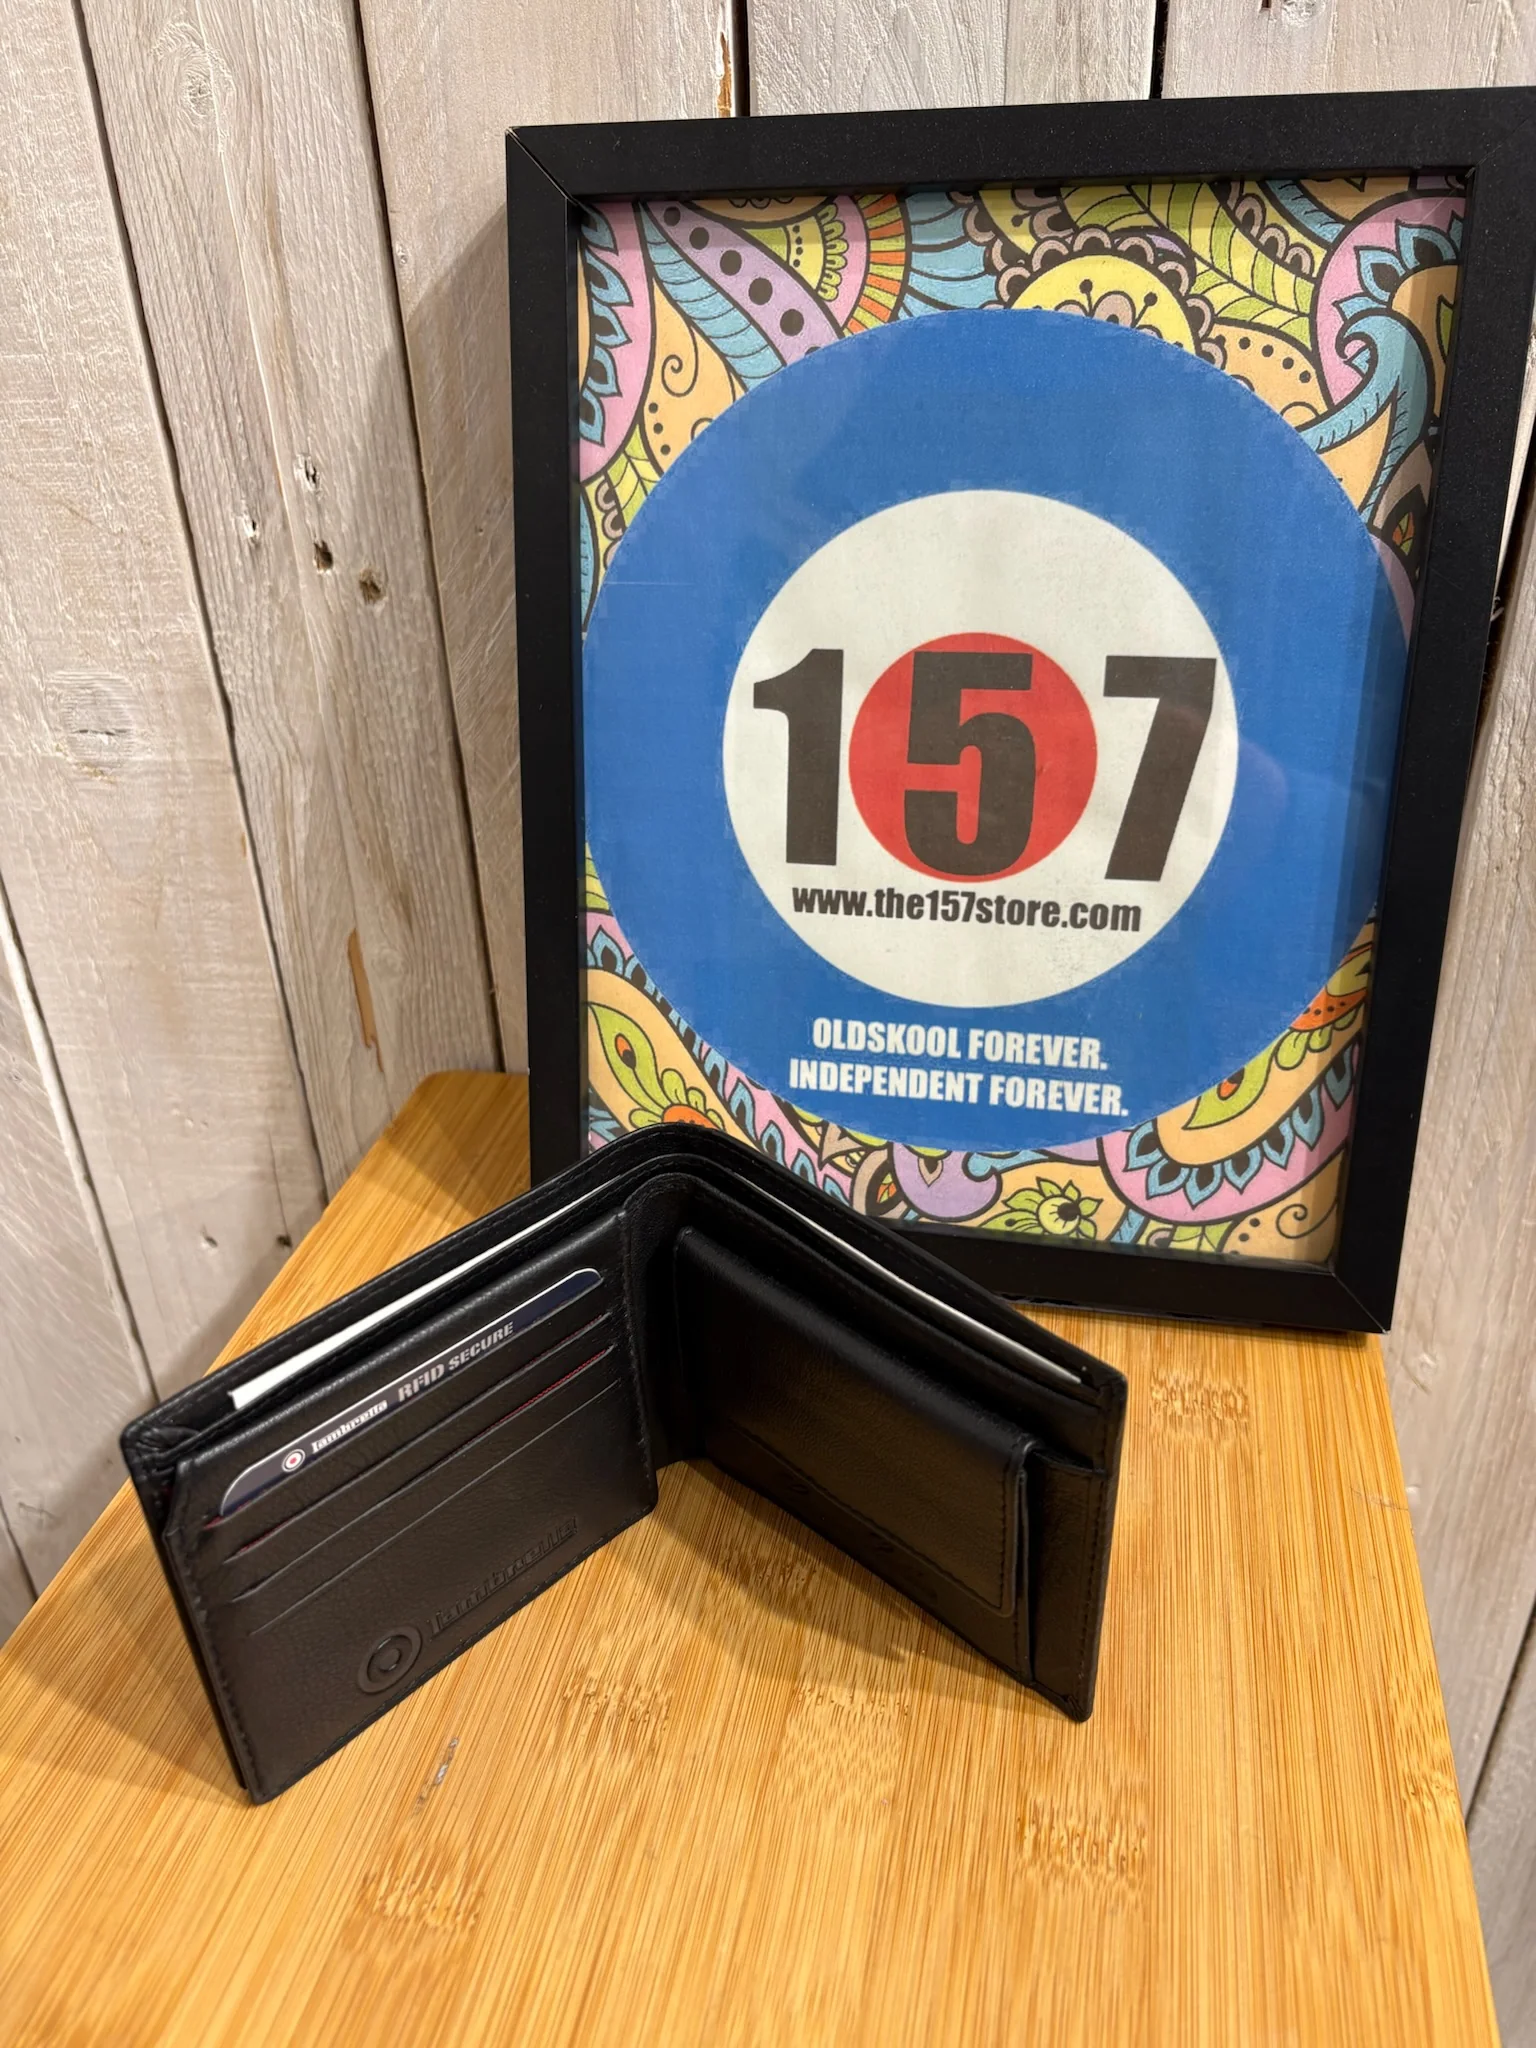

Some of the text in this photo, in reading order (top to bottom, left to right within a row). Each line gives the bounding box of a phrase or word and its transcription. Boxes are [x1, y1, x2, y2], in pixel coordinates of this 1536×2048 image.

[753, 648, 1217, 882] 157
[792, 887, 1142, 932] www.the157store.com
[813, 1017, 1108, 1070] OLDSKOOL FOREVER.
[789, 1058, 1129, 1117] INDEPENDENT FOREVER.
[398, 1363, 445, 1402] RFID
[448, 1321, 514, 1371] SECURE
